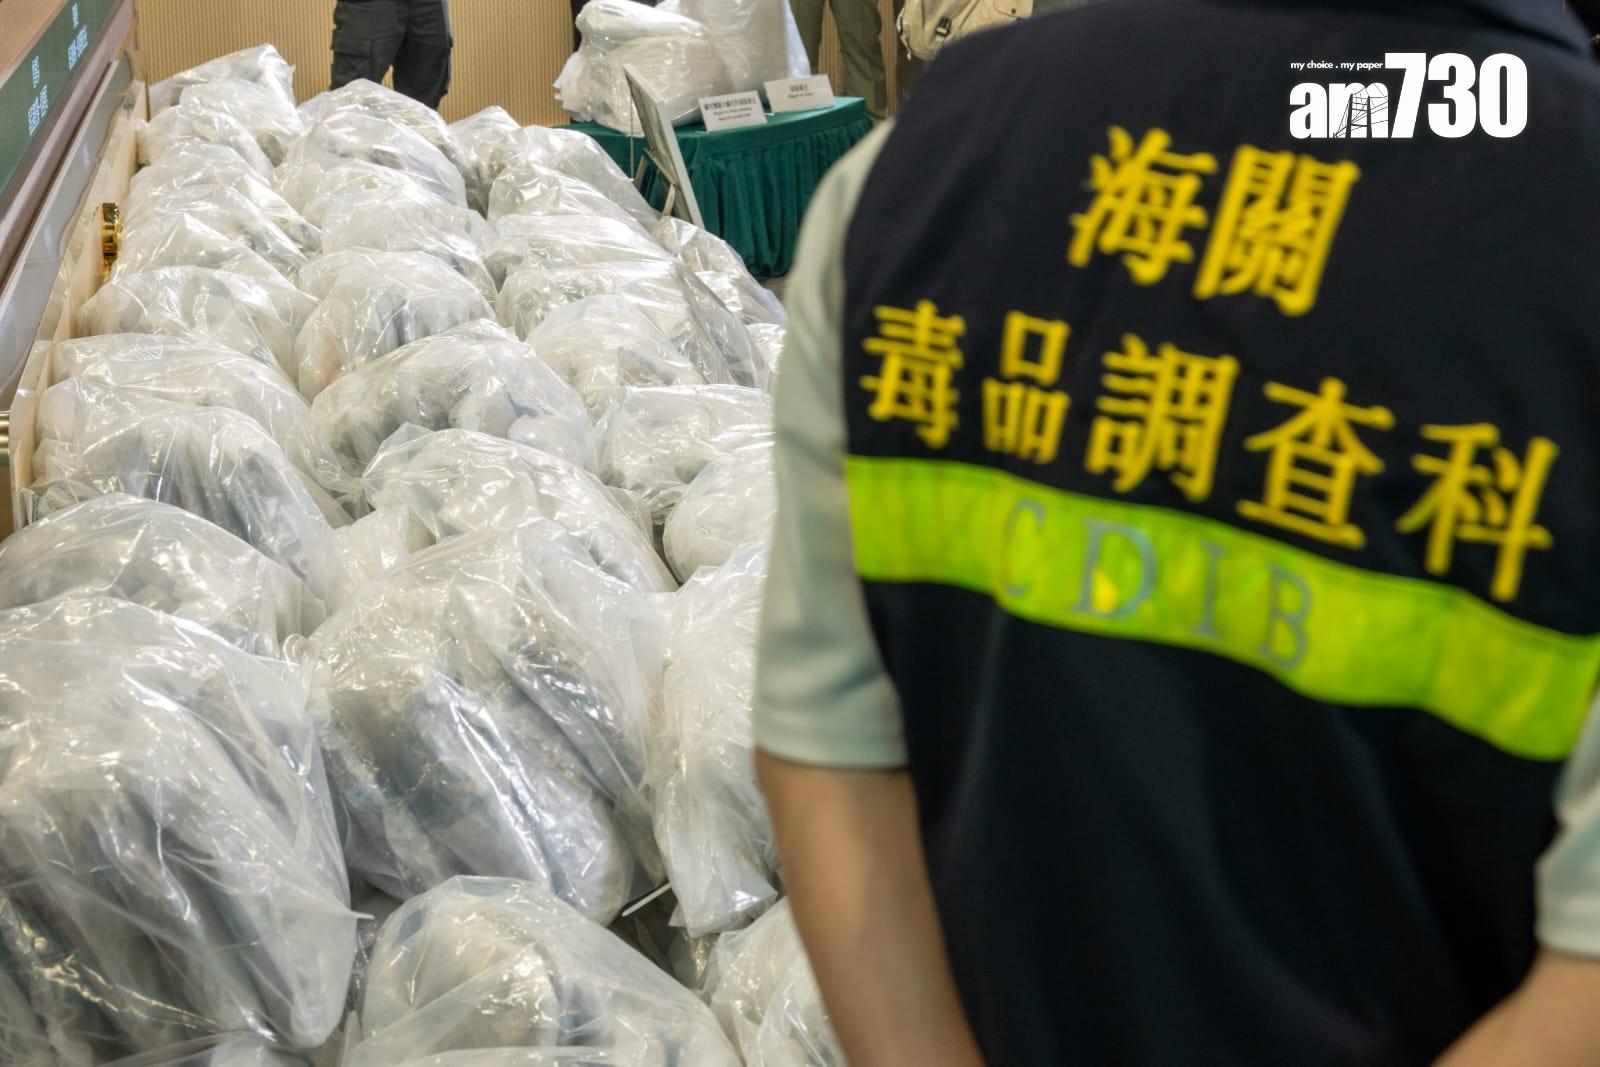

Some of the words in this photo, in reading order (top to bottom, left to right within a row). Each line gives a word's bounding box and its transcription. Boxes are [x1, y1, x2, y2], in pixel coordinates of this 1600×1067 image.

[1068, 125, 1361, 316] 海關
[860, 300, 1560, 602] 毒品調查科
